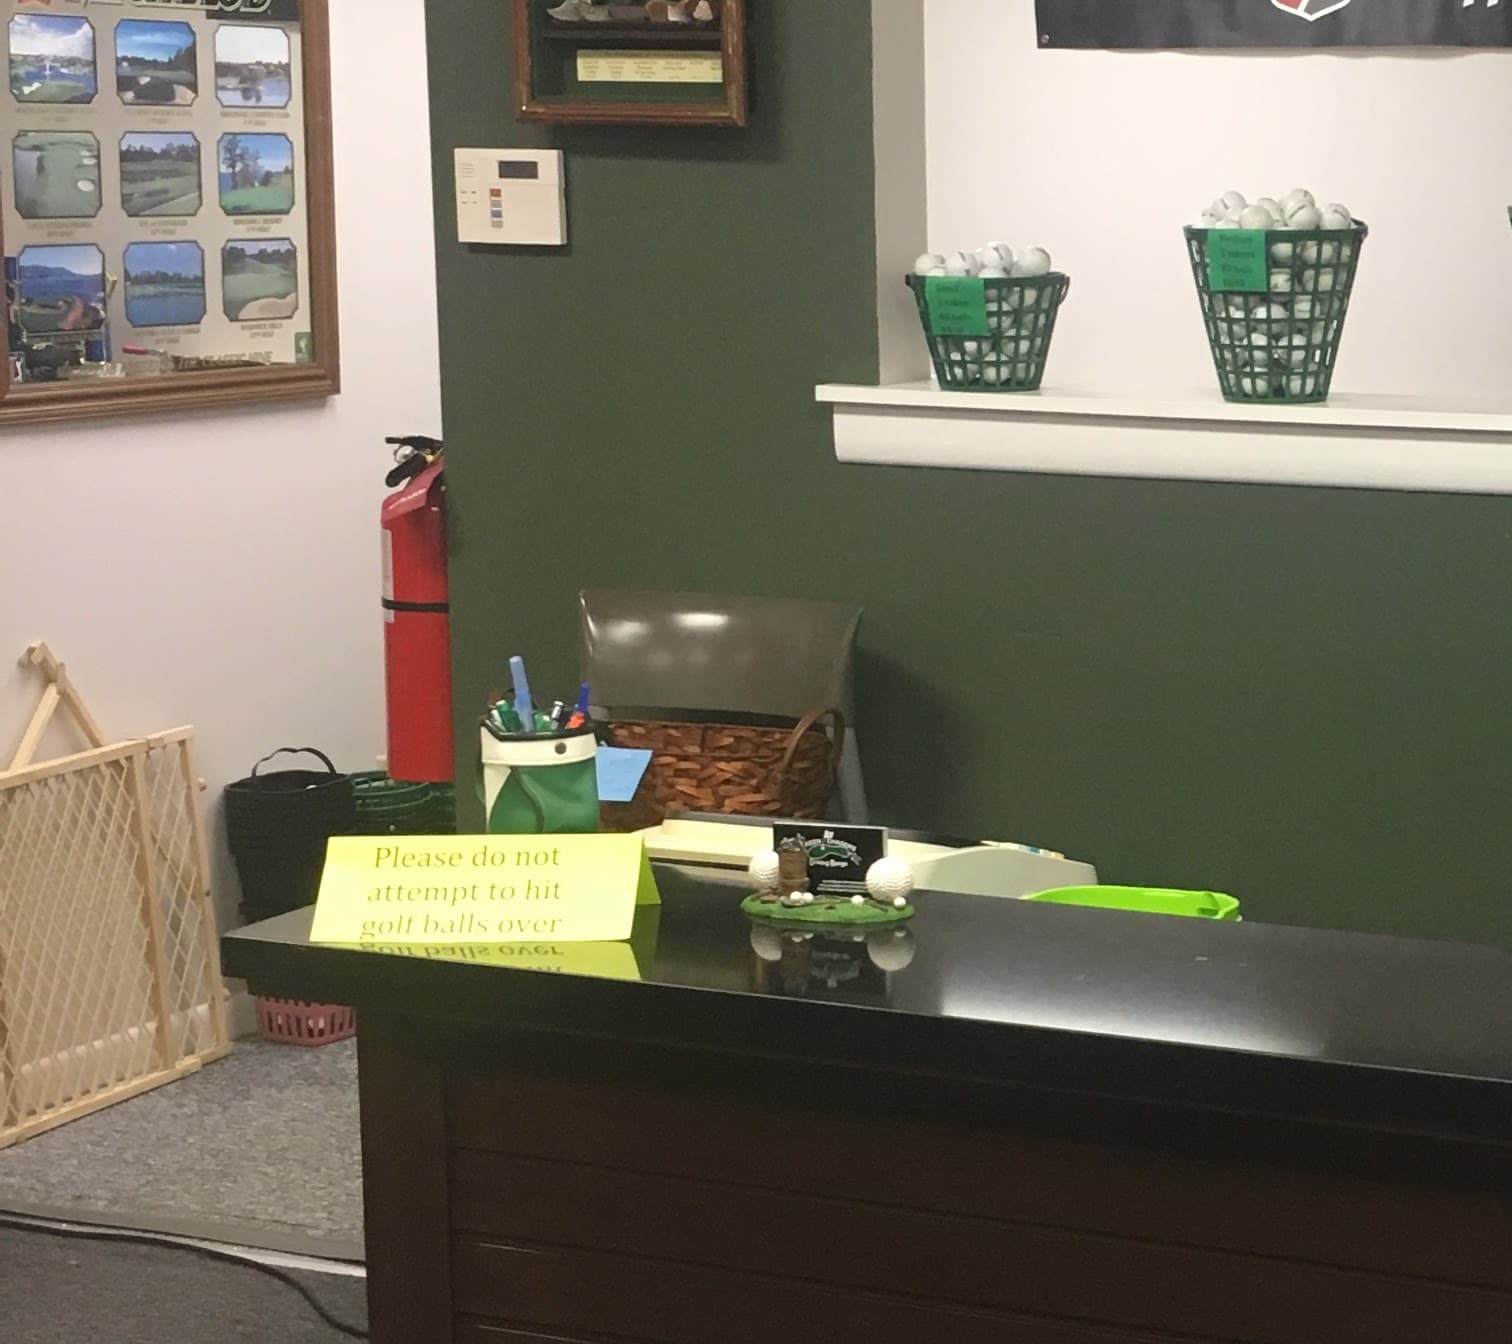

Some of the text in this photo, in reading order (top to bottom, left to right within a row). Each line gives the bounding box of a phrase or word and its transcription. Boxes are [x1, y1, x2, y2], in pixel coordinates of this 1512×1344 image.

[374, 846, 560, 868] Please do not
[367, 880, 561, 906] attempt to hit
[360, 914, 562, 940] golf balls over
